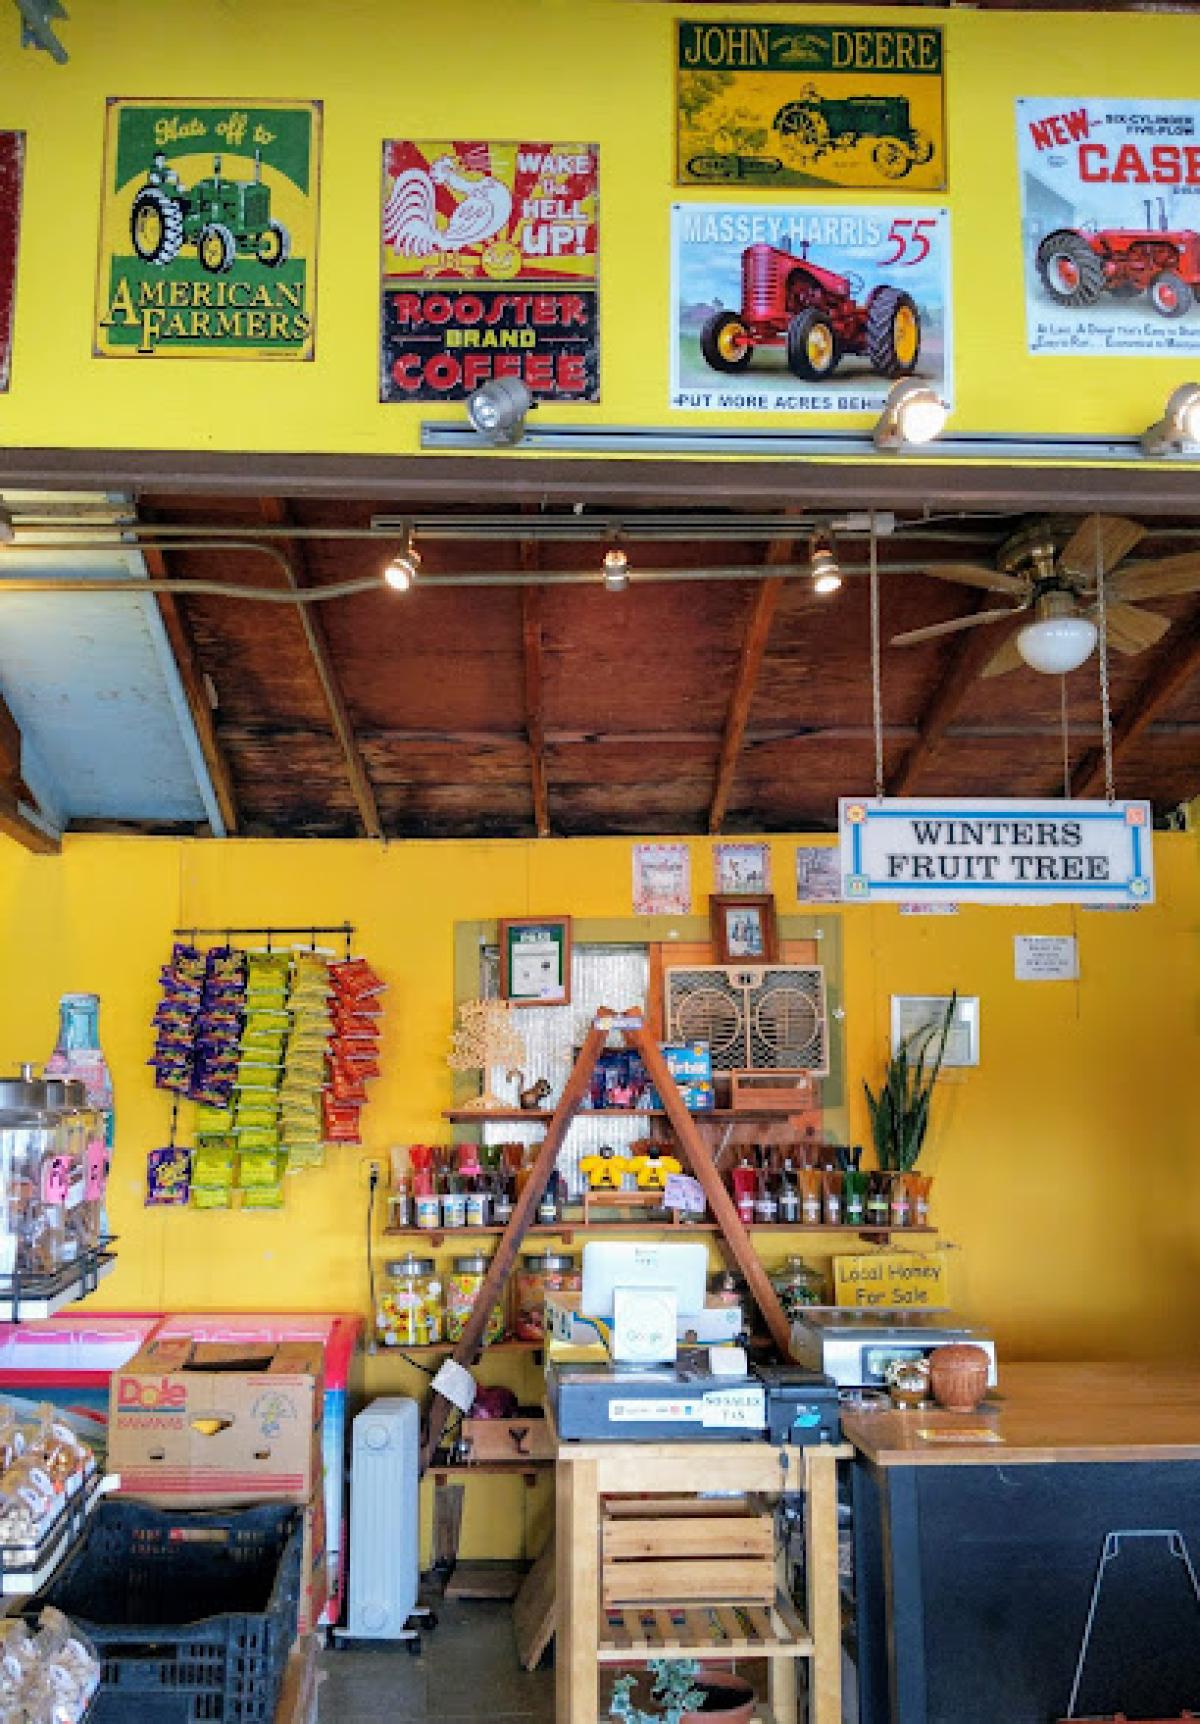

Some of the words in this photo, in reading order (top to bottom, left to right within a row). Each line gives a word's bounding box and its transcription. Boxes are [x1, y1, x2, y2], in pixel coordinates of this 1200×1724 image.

[684, 25, 769, 66] JOHN
[831, 31, 939, 69] DEERE
[154, 115, 207, 146] Hats
[215, 111, 248, 145] off
[253, 123, 277, 145] to
[517, 152, 591, 174] WAKE
[1078, 143, 1200, 185] CASE
[522, 199, 588, 220] HELL
[522, 225, 588, 255] UP!
[683, 213, 882, 246] MASSEY-HARRIS
[875, 217, 938, 267] 55
[100, 277, 304, 328] AMERICAN
[393, 293, 589, 325] ROOSTER
[137, 307, 311, 353] FARMERS
[445, 329, 536, 348] BRAND
[392, 353, 586, 392] COFFEE
[679, 393, 713, 408] PUT
[718, 395, 769, 408] MORE
[775, 396, 833, 410] ACRES
[909, 820, 1083, 847] WINTERS
[886, 854, 999, 880] FRUIT
[1010, 854, 1110, 881] TREE
[840, 1264, 883, 1283] Local
[888, 1264, 942, 1282] Honey
[856, 1287, 886, 1306] For
[891, 1286, 928, 1304] Sale
[118, 1376, 187, 1409] Dole
